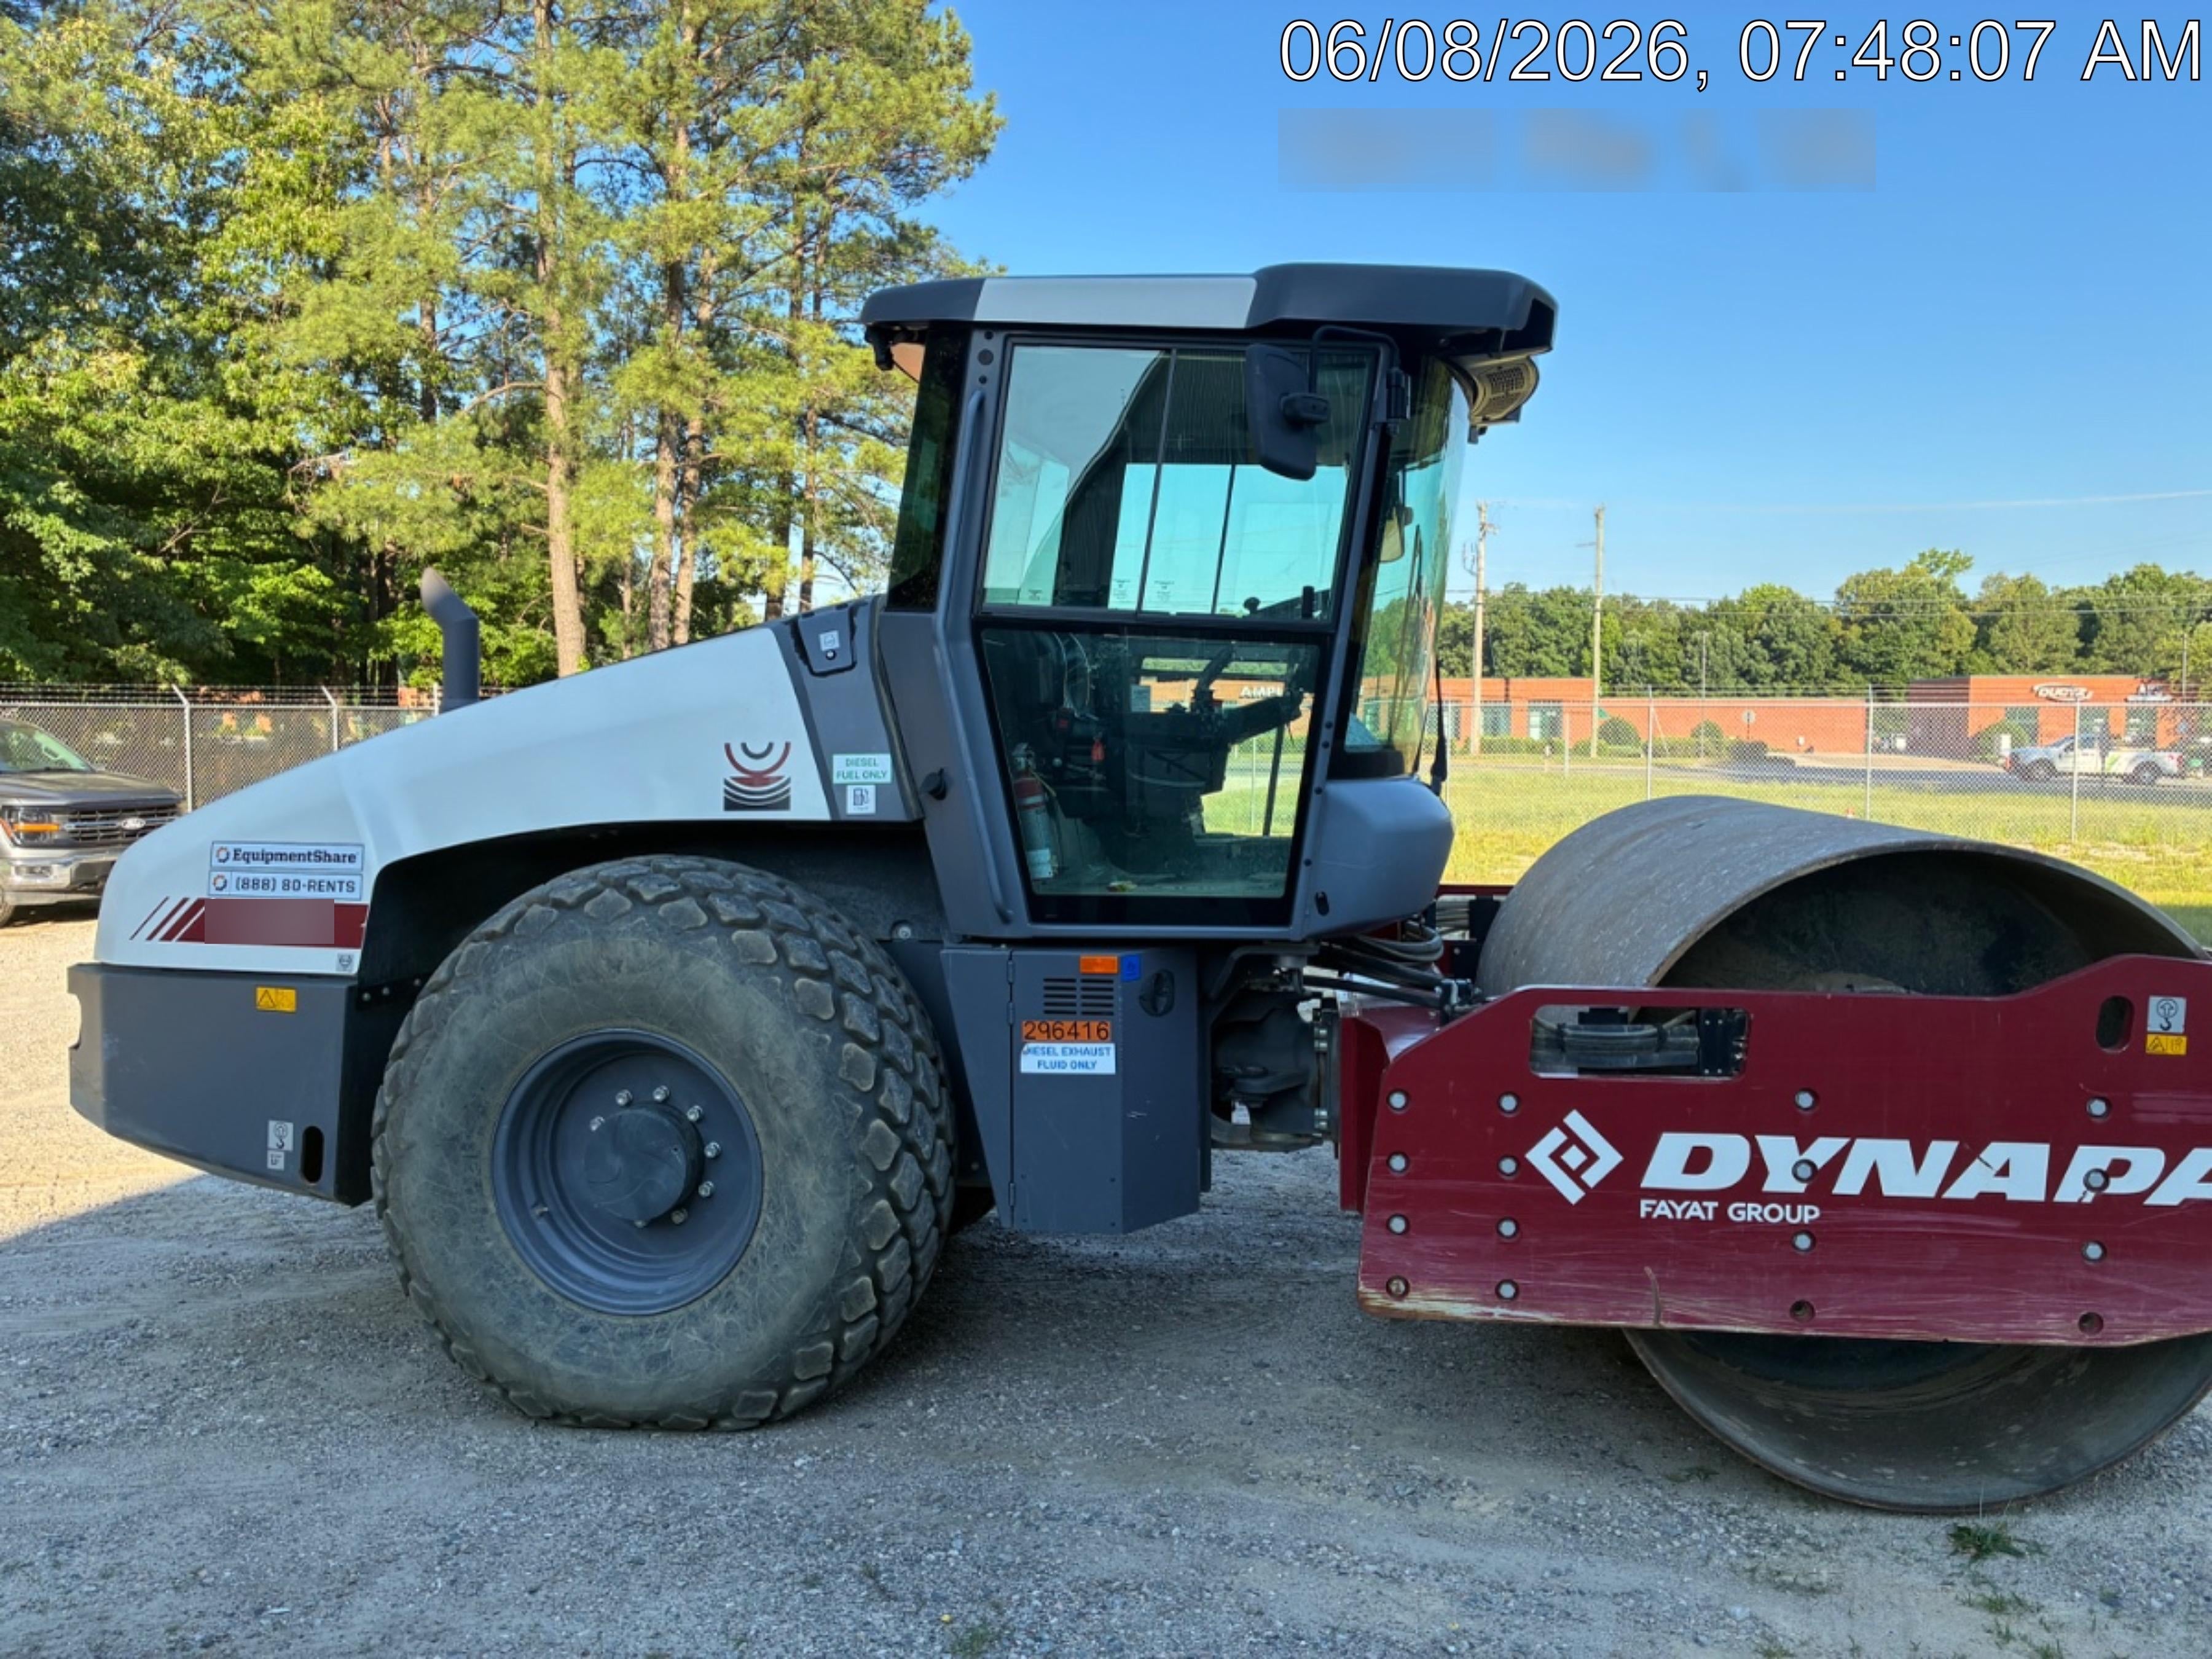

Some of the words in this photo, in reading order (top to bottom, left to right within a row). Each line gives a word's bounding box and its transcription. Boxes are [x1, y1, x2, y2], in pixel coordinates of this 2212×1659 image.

[845, 758, 879, 767] DIESEL
[836, 770, 859, 780] FUEL
[862, 770, 887, 780] ONLY
[233, 848, 356, 865] EquipmentShare
[235, 877, 276, 891] (888)
[1024, 1021, 1108, 1040] 296416
[1061, 1046, 1111, 1057] EXHAUST
[1037, 1060, 1067, 1069] FLUID
[1070, 1061, 1097, 1070] ONLY
[1640, 1132, 2212, 1206] DYNAPA
[1640, 1199, 1718, 1221] FAYAT
[1727, 1202, 1820, 1224] GROUP
